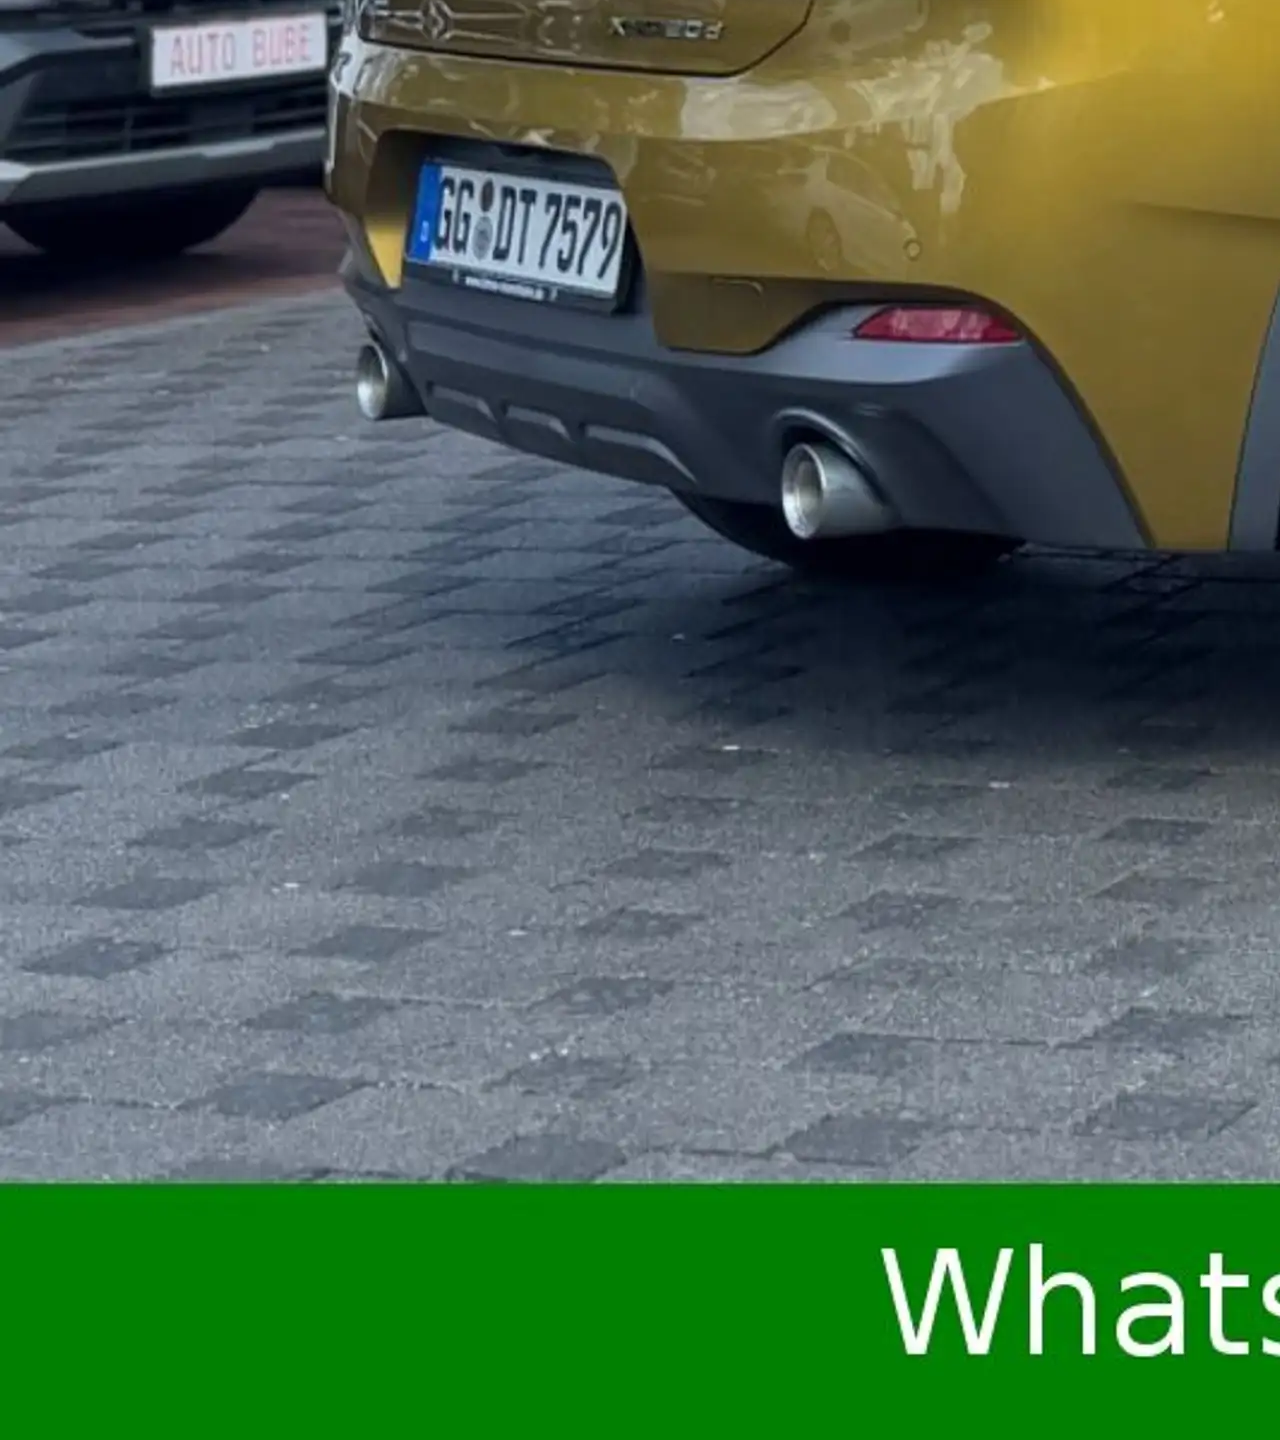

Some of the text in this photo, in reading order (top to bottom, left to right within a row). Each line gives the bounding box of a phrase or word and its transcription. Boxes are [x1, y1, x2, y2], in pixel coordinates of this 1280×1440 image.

[170, 24, 313, 77] AUTO BUBE
[434, 175, 474, 254] GG
[492, 185, 537, 264] DT
[538, 192, 622, 279] 7579
